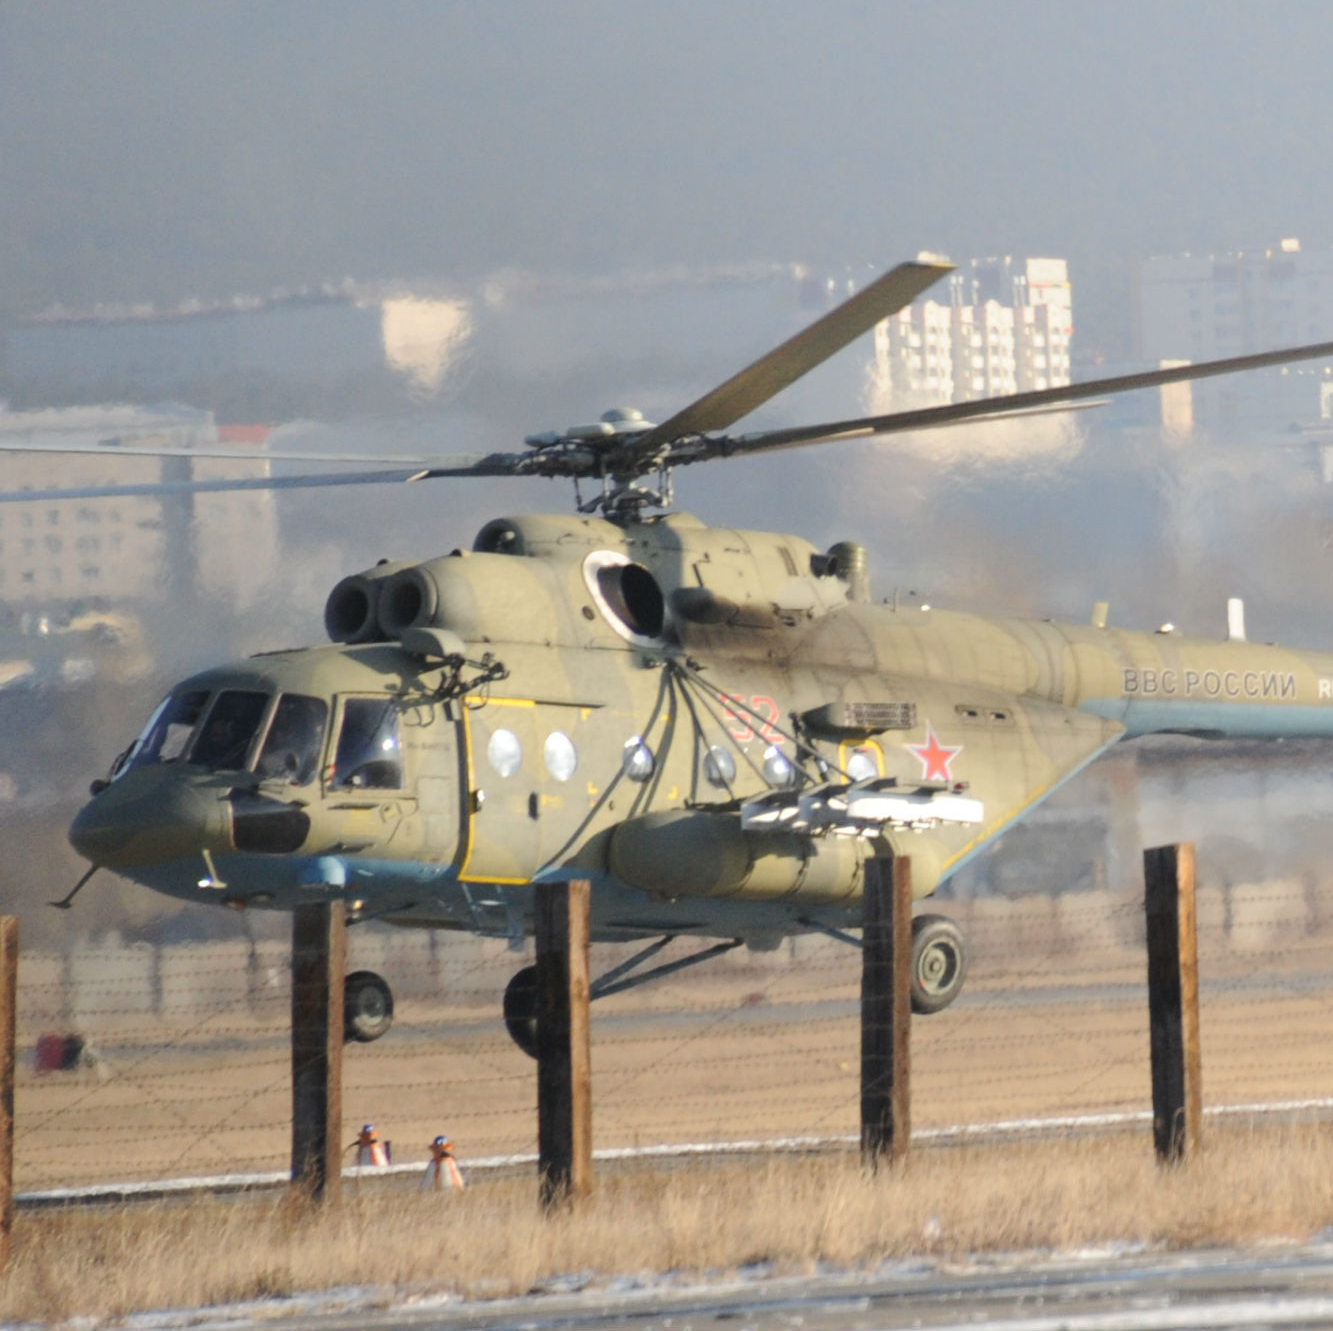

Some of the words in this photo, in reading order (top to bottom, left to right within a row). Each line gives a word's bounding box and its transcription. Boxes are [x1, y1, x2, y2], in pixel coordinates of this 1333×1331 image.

[1122, 667, 1177, 696] ВВС
[1183, 669, 1298, 699] РОССИИ
[720, 693, 785, 744] 52
